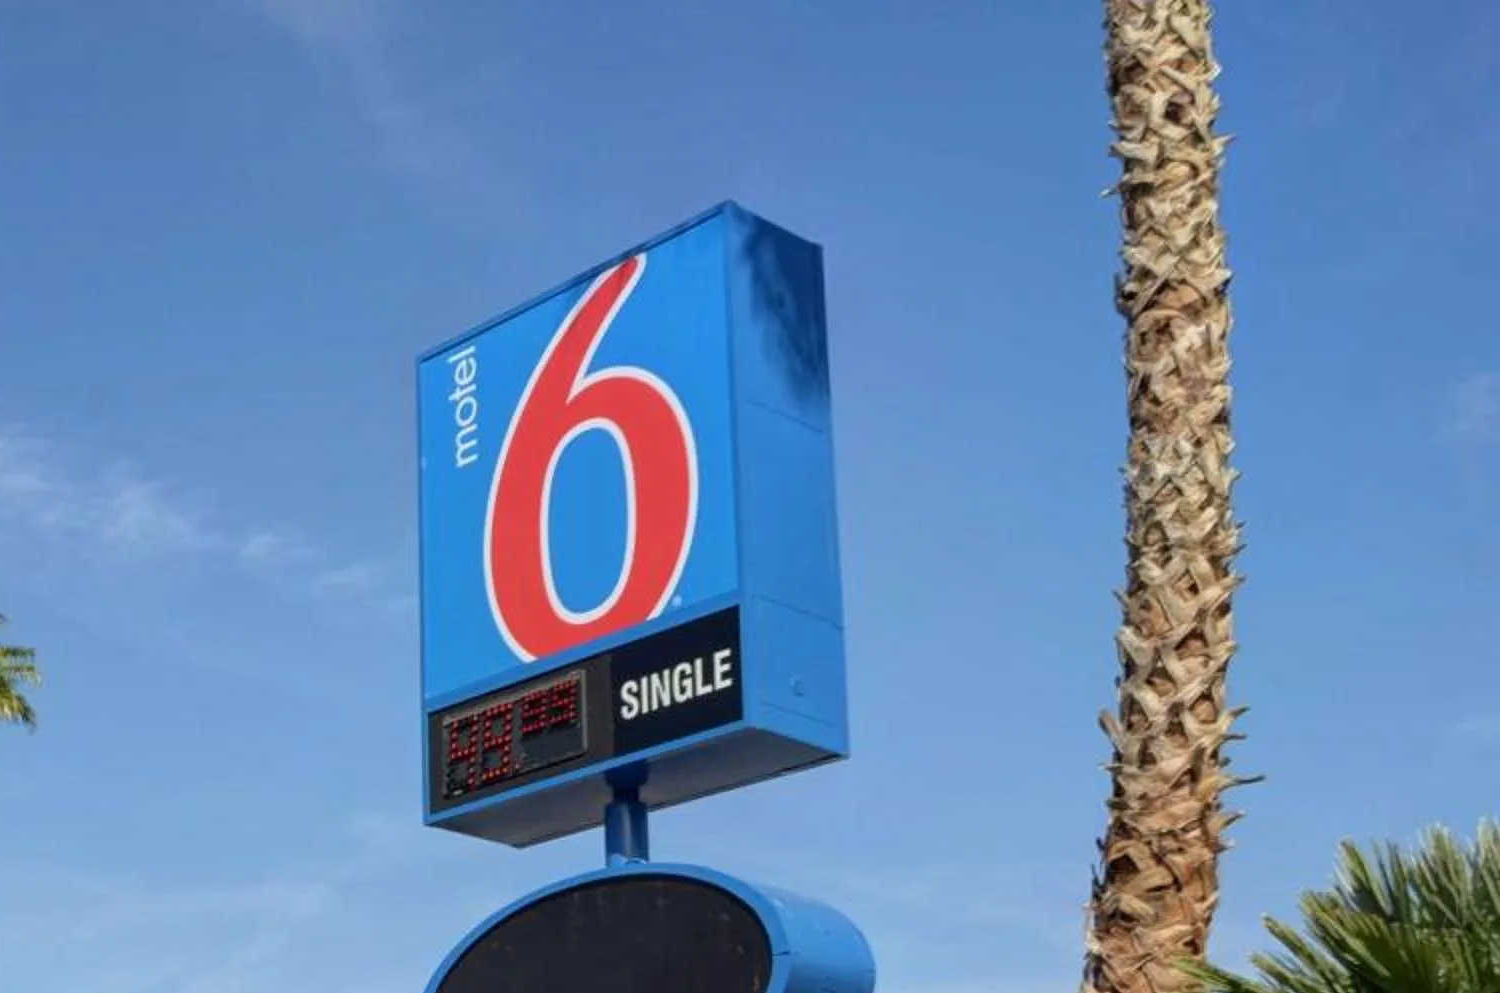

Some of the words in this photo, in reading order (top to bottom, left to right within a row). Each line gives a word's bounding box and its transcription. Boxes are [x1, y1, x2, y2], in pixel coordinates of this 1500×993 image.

[446, 345, 478, 468] motel
[484, 253, 699, 662] 6
[620, 648, 733, 720] SINGLE
